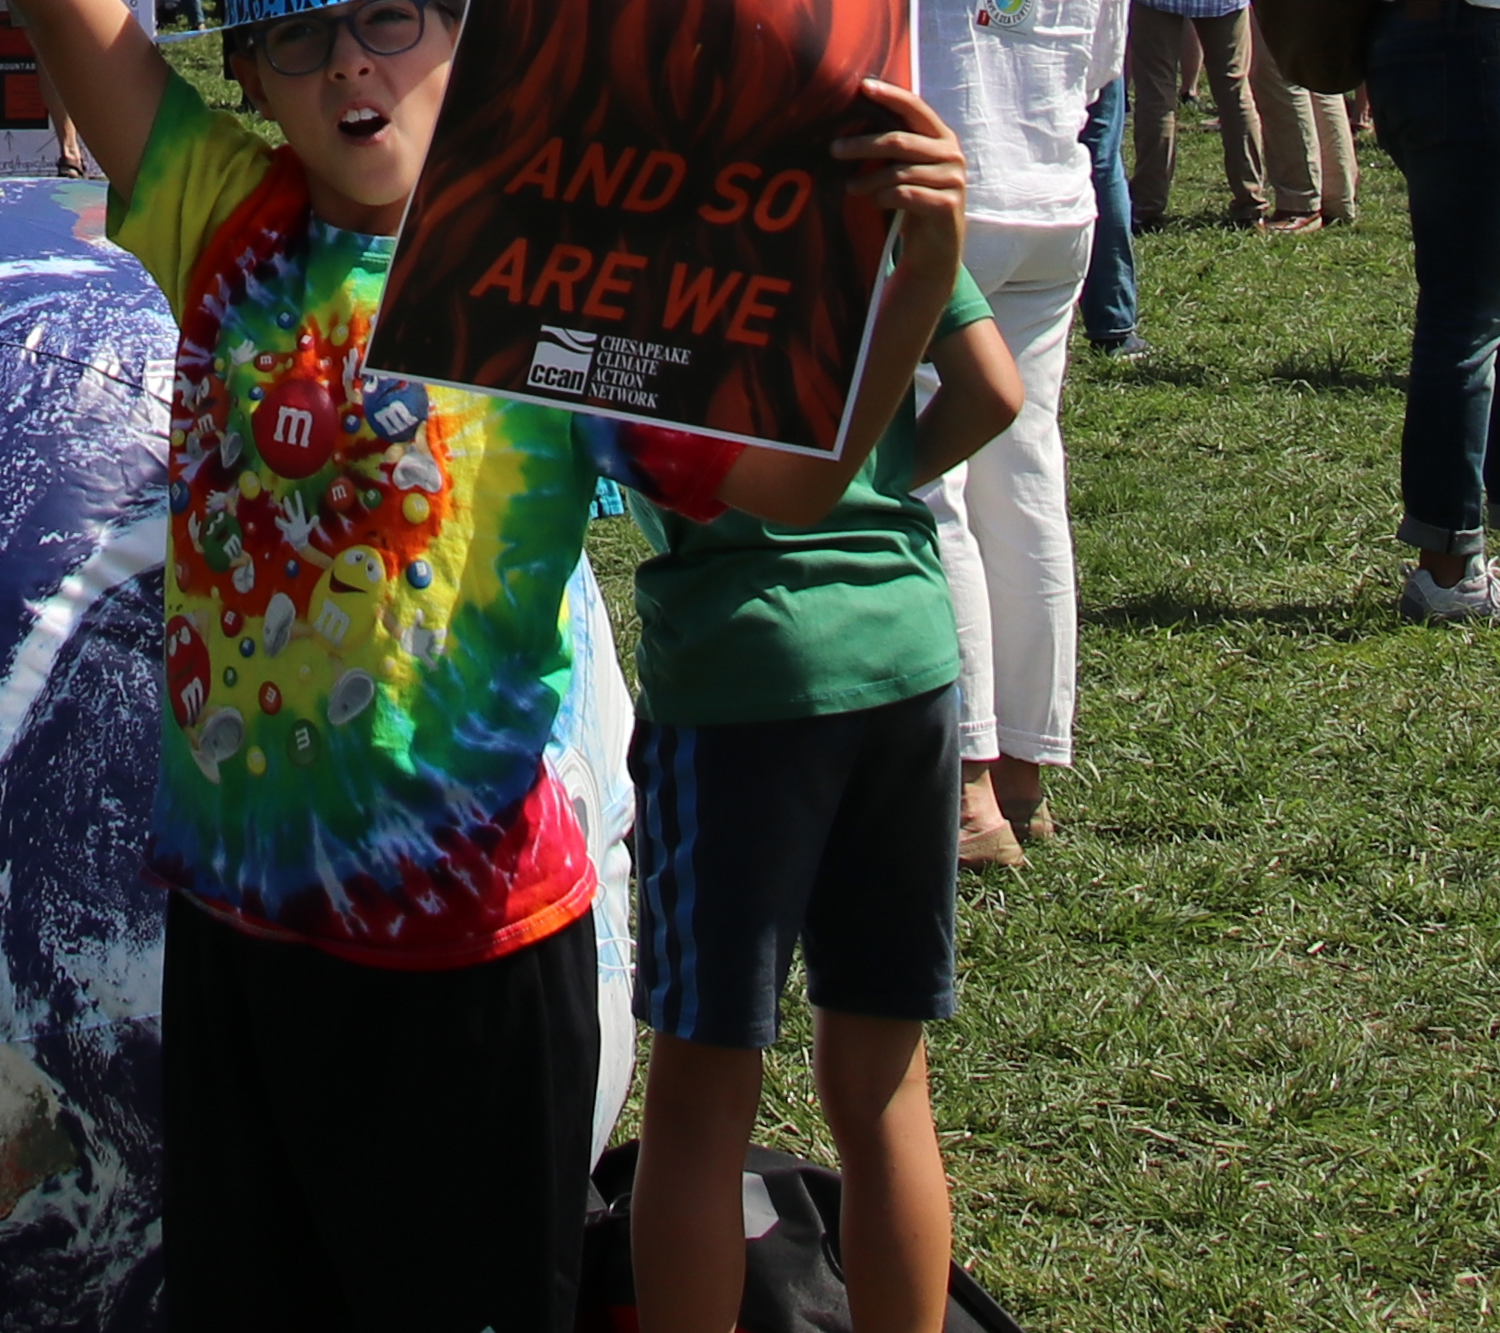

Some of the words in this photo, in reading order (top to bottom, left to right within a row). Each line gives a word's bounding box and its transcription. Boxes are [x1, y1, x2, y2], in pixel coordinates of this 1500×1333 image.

[505, 137, 685, 213] AND
[699, 162, 812, 232] SO
[470, 238, 645, 321] ARE
[664, 261, 791, 347] WE
[597, 351, 658, 375] CLIMATE
[600, 335, 691, 365] CHESAPEAKE
[531, 364, 585, 391] ccan
[592, 368, 645, 389] ACTION
[588, 383, 658, 408] NETWORK
[274, 404, 313, 448] m
[373, 400, 418, 436] m
[313, 599, 350, 648] m
